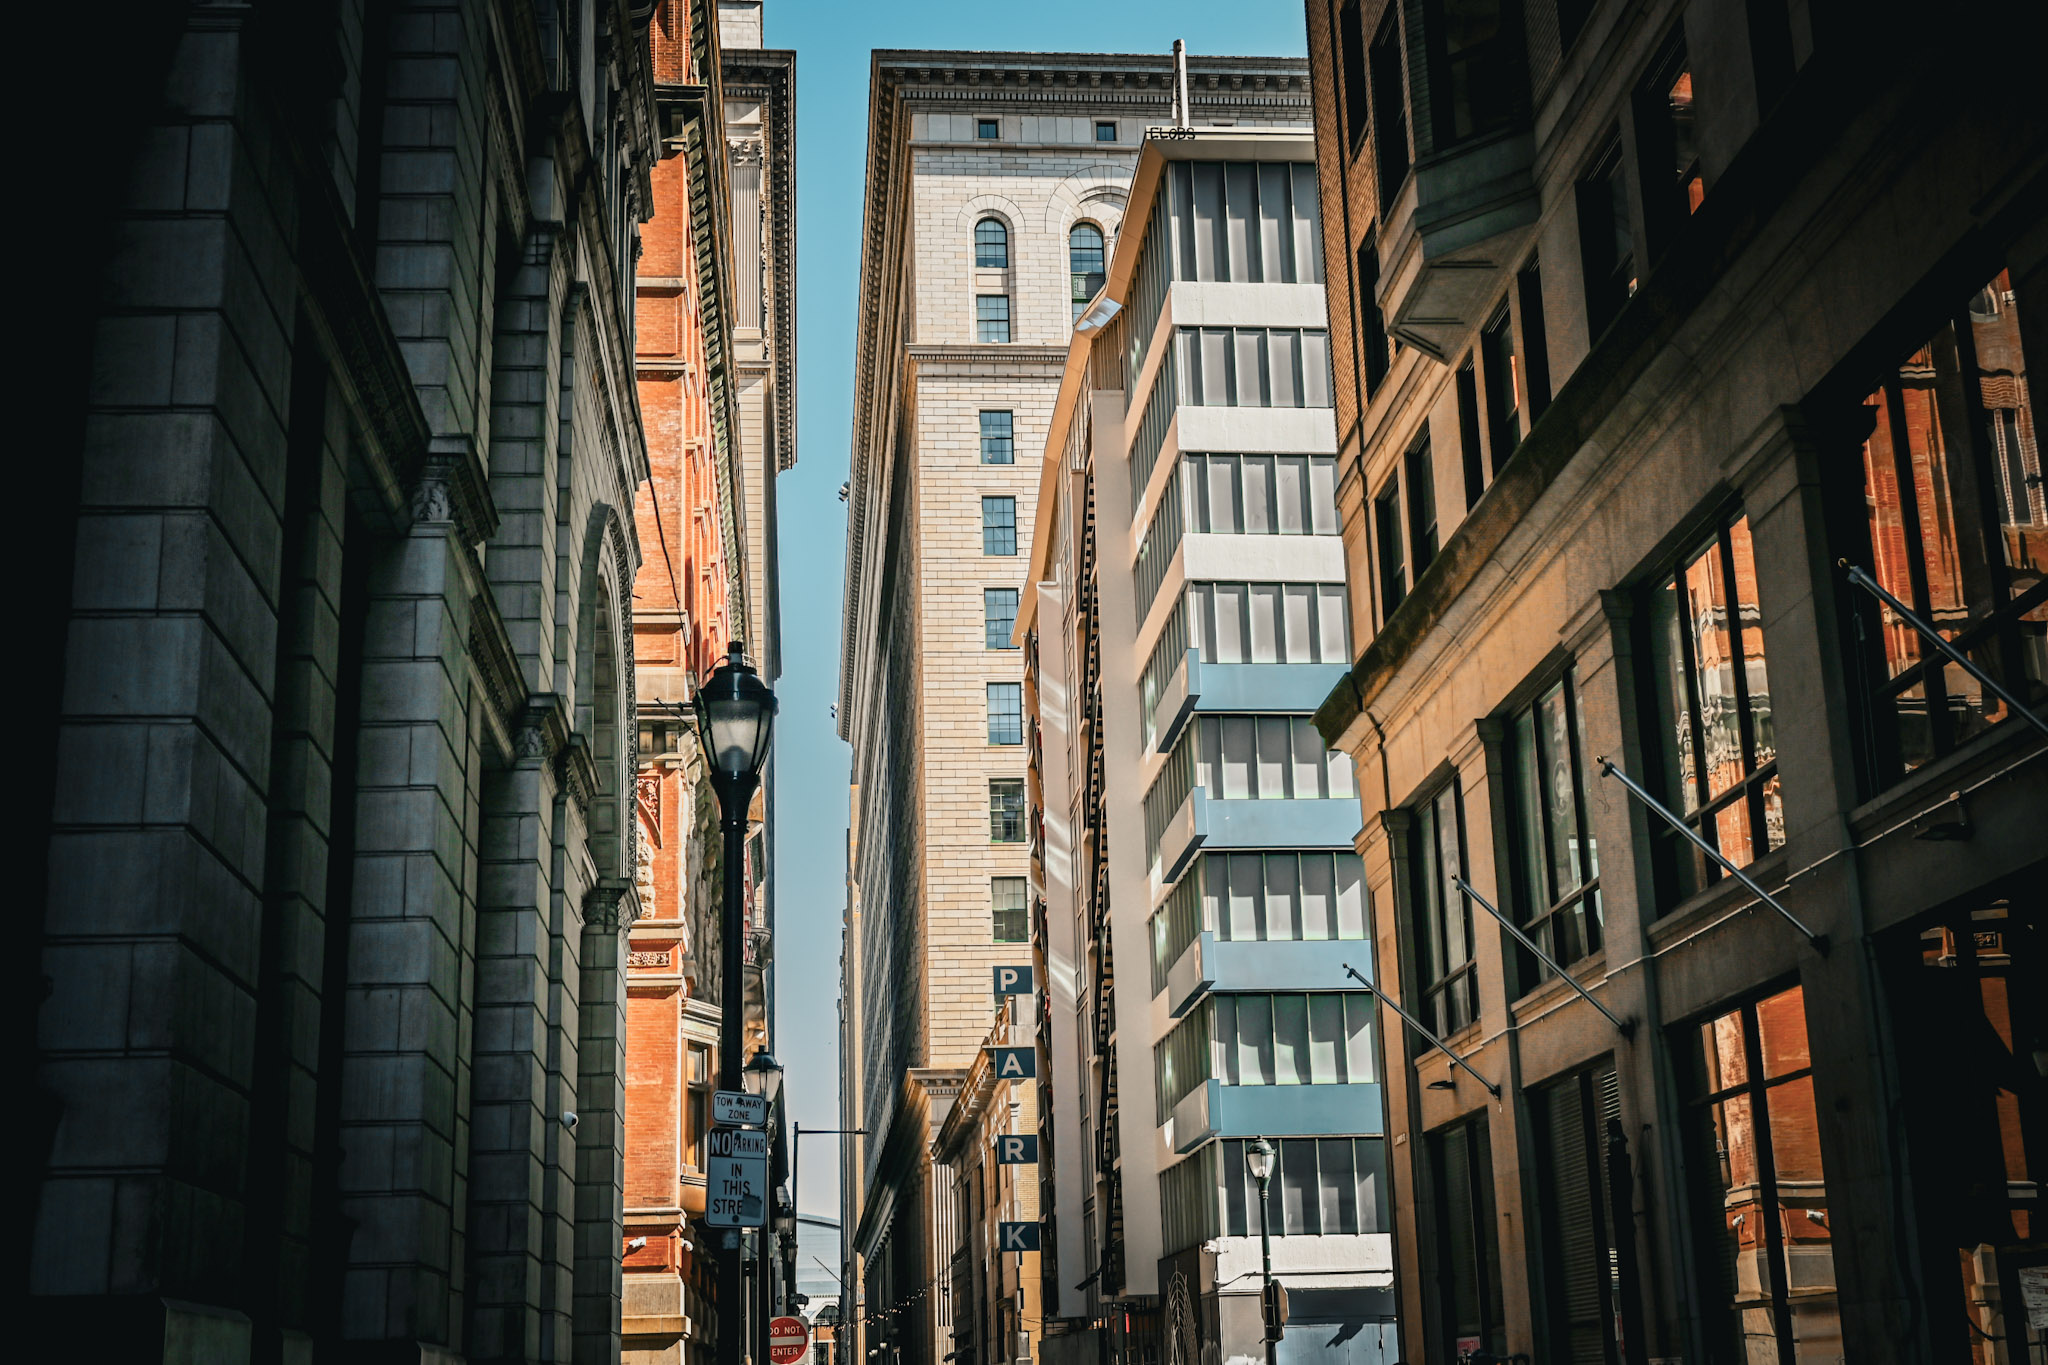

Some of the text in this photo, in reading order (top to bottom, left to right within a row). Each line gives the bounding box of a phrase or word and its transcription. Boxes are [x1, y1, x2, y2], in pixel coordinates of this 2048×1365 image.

[716, 1096, 733, 1107] TOW
[999, 968, 1027, 1249] PARK
[728, 1109, 750, 1120] ZONE
[711, 1132, 765, 1155] NO PARKING
[731, 1163, 742, 1177] IN
[722, 1180, 750, 1196] THIS
[713, 1198, 745, 1215] STRE
[784, 1325, 800, 1335] NOT
[772, 1347, 798, 1357] ENTER
